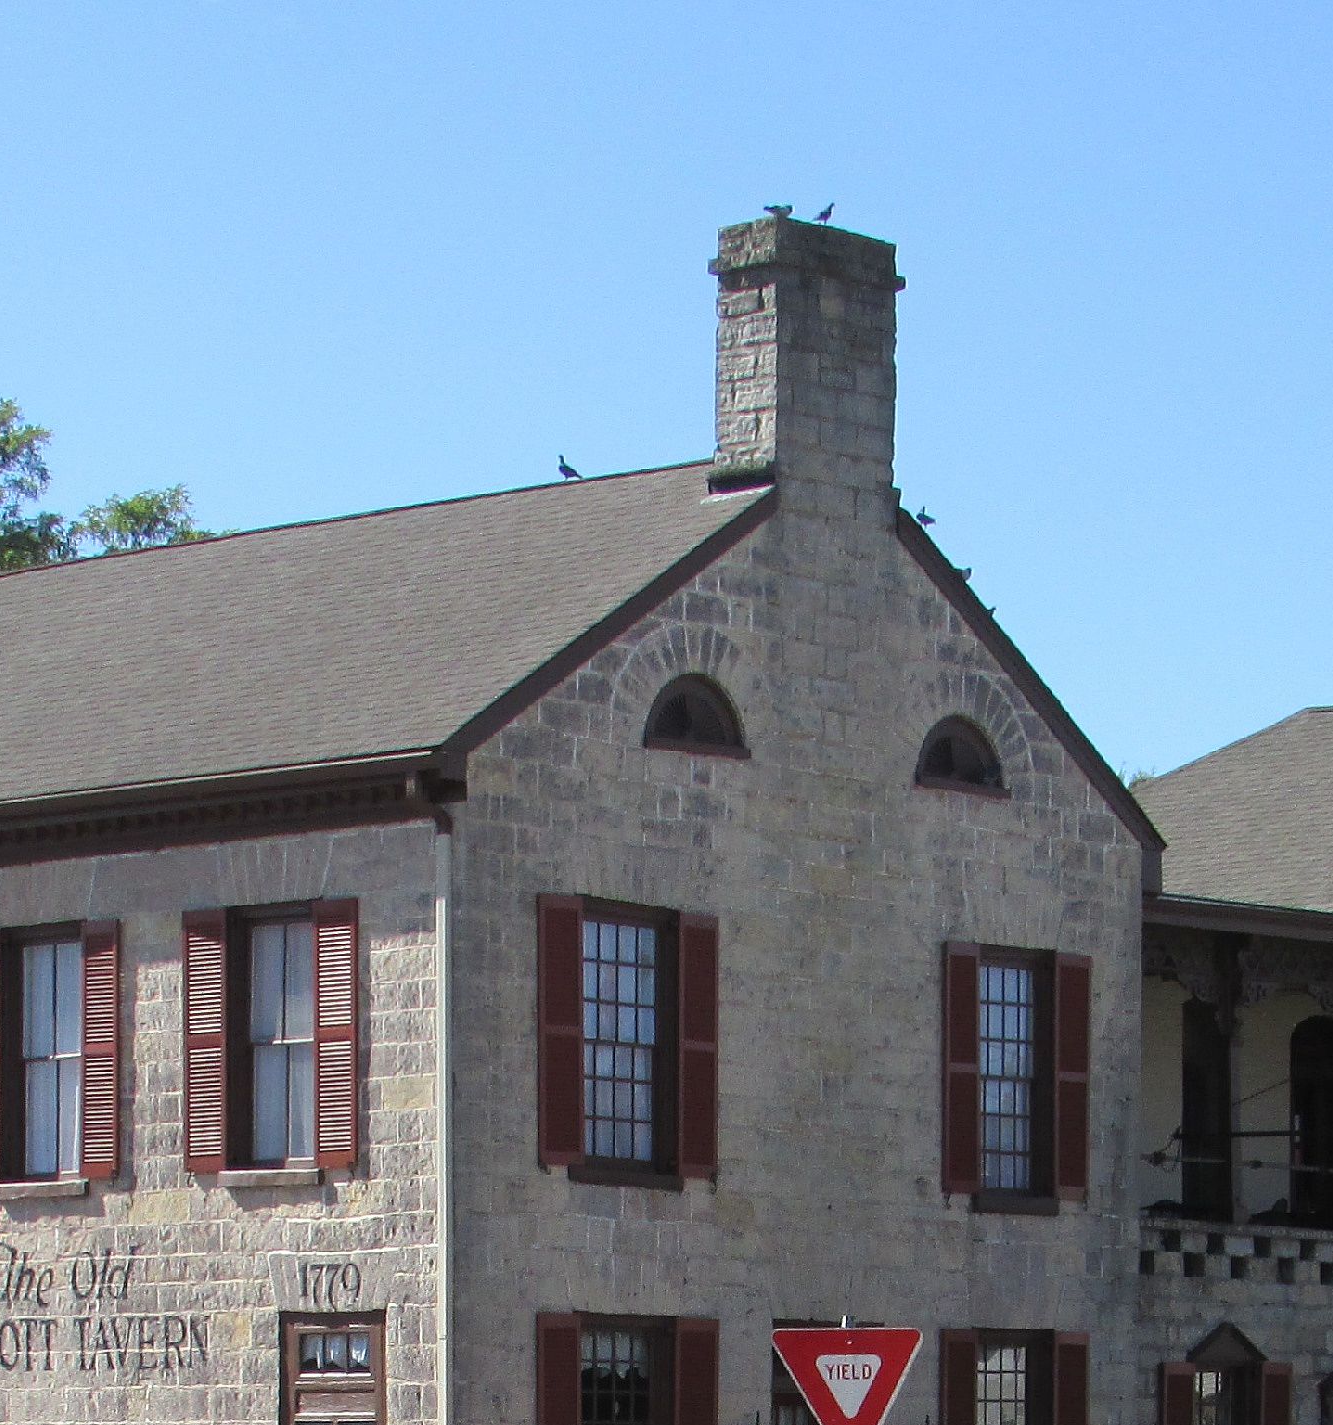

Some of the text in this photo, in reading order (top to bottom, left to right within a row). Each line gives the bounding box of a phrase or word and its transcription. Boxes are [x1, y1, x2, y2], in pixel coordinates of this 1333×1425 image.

[71, 1242, 145, 1301] Old
[74, 1315, 210, 1371] TAVERN
[825, 1364, 873, 1380] YIELD
